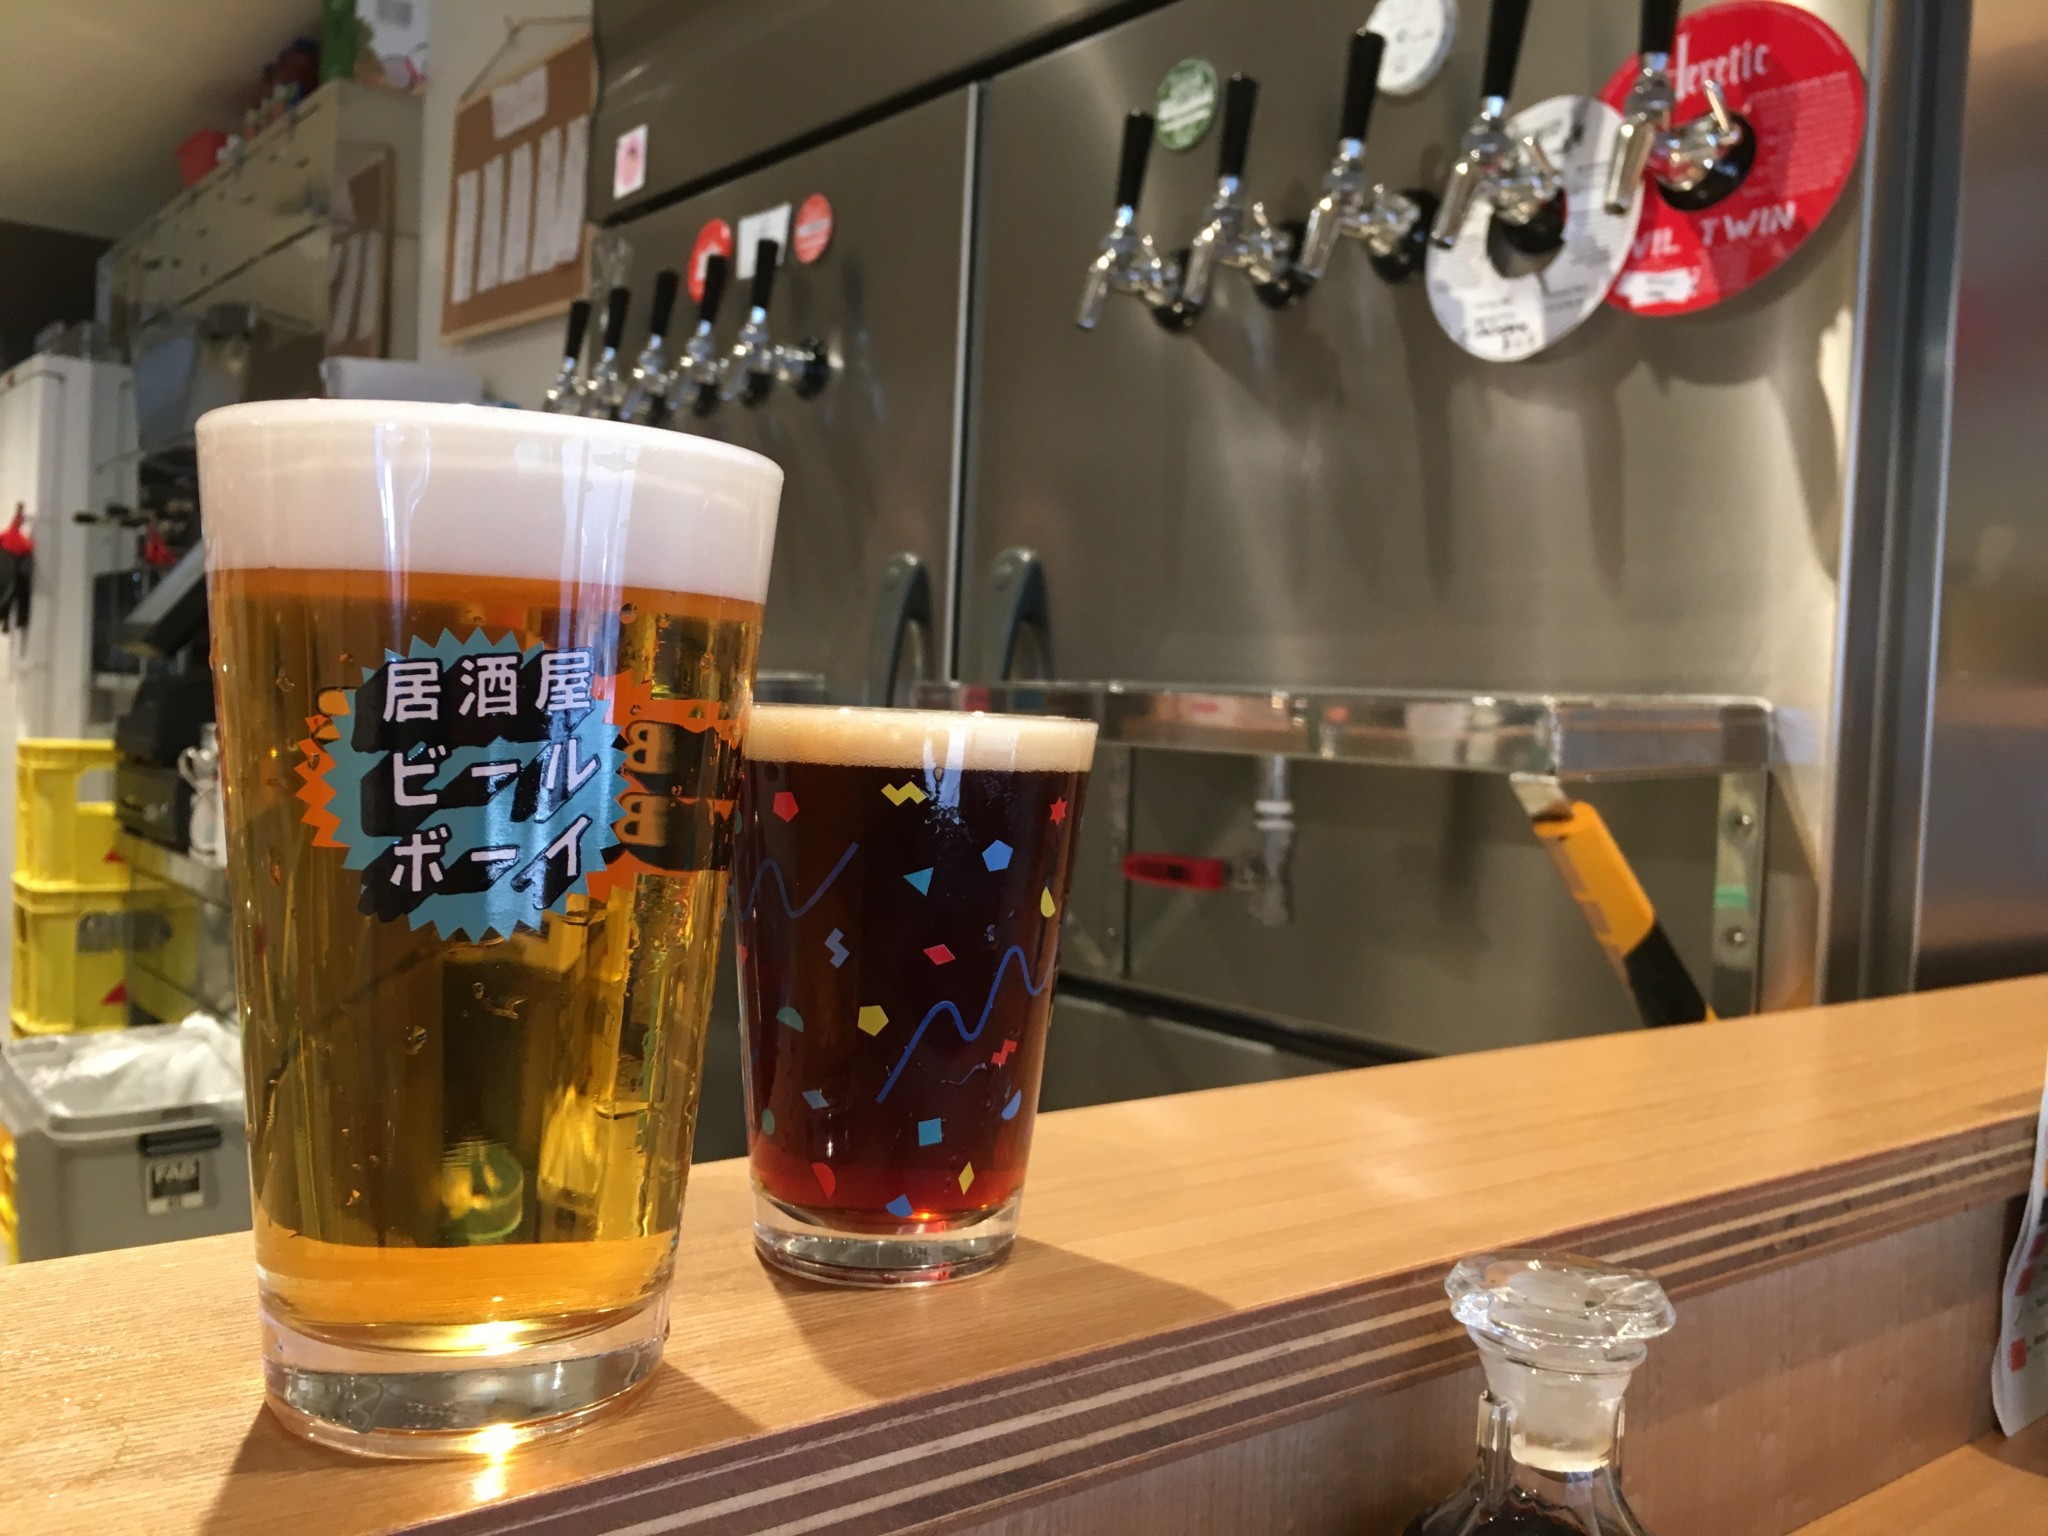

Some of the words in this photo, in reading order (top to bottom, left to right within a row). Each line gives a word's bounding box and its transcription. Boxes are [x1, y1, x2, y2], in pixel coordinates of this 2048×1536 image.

[1629, 227, 1683, 261] VIL
[1700, 200, 1797, 249] TWIN
[381, 649, 594, 723] 居酒屋
[392, 738, 601, 807] ビール
[389, 815, 593, 892] ボーイ
